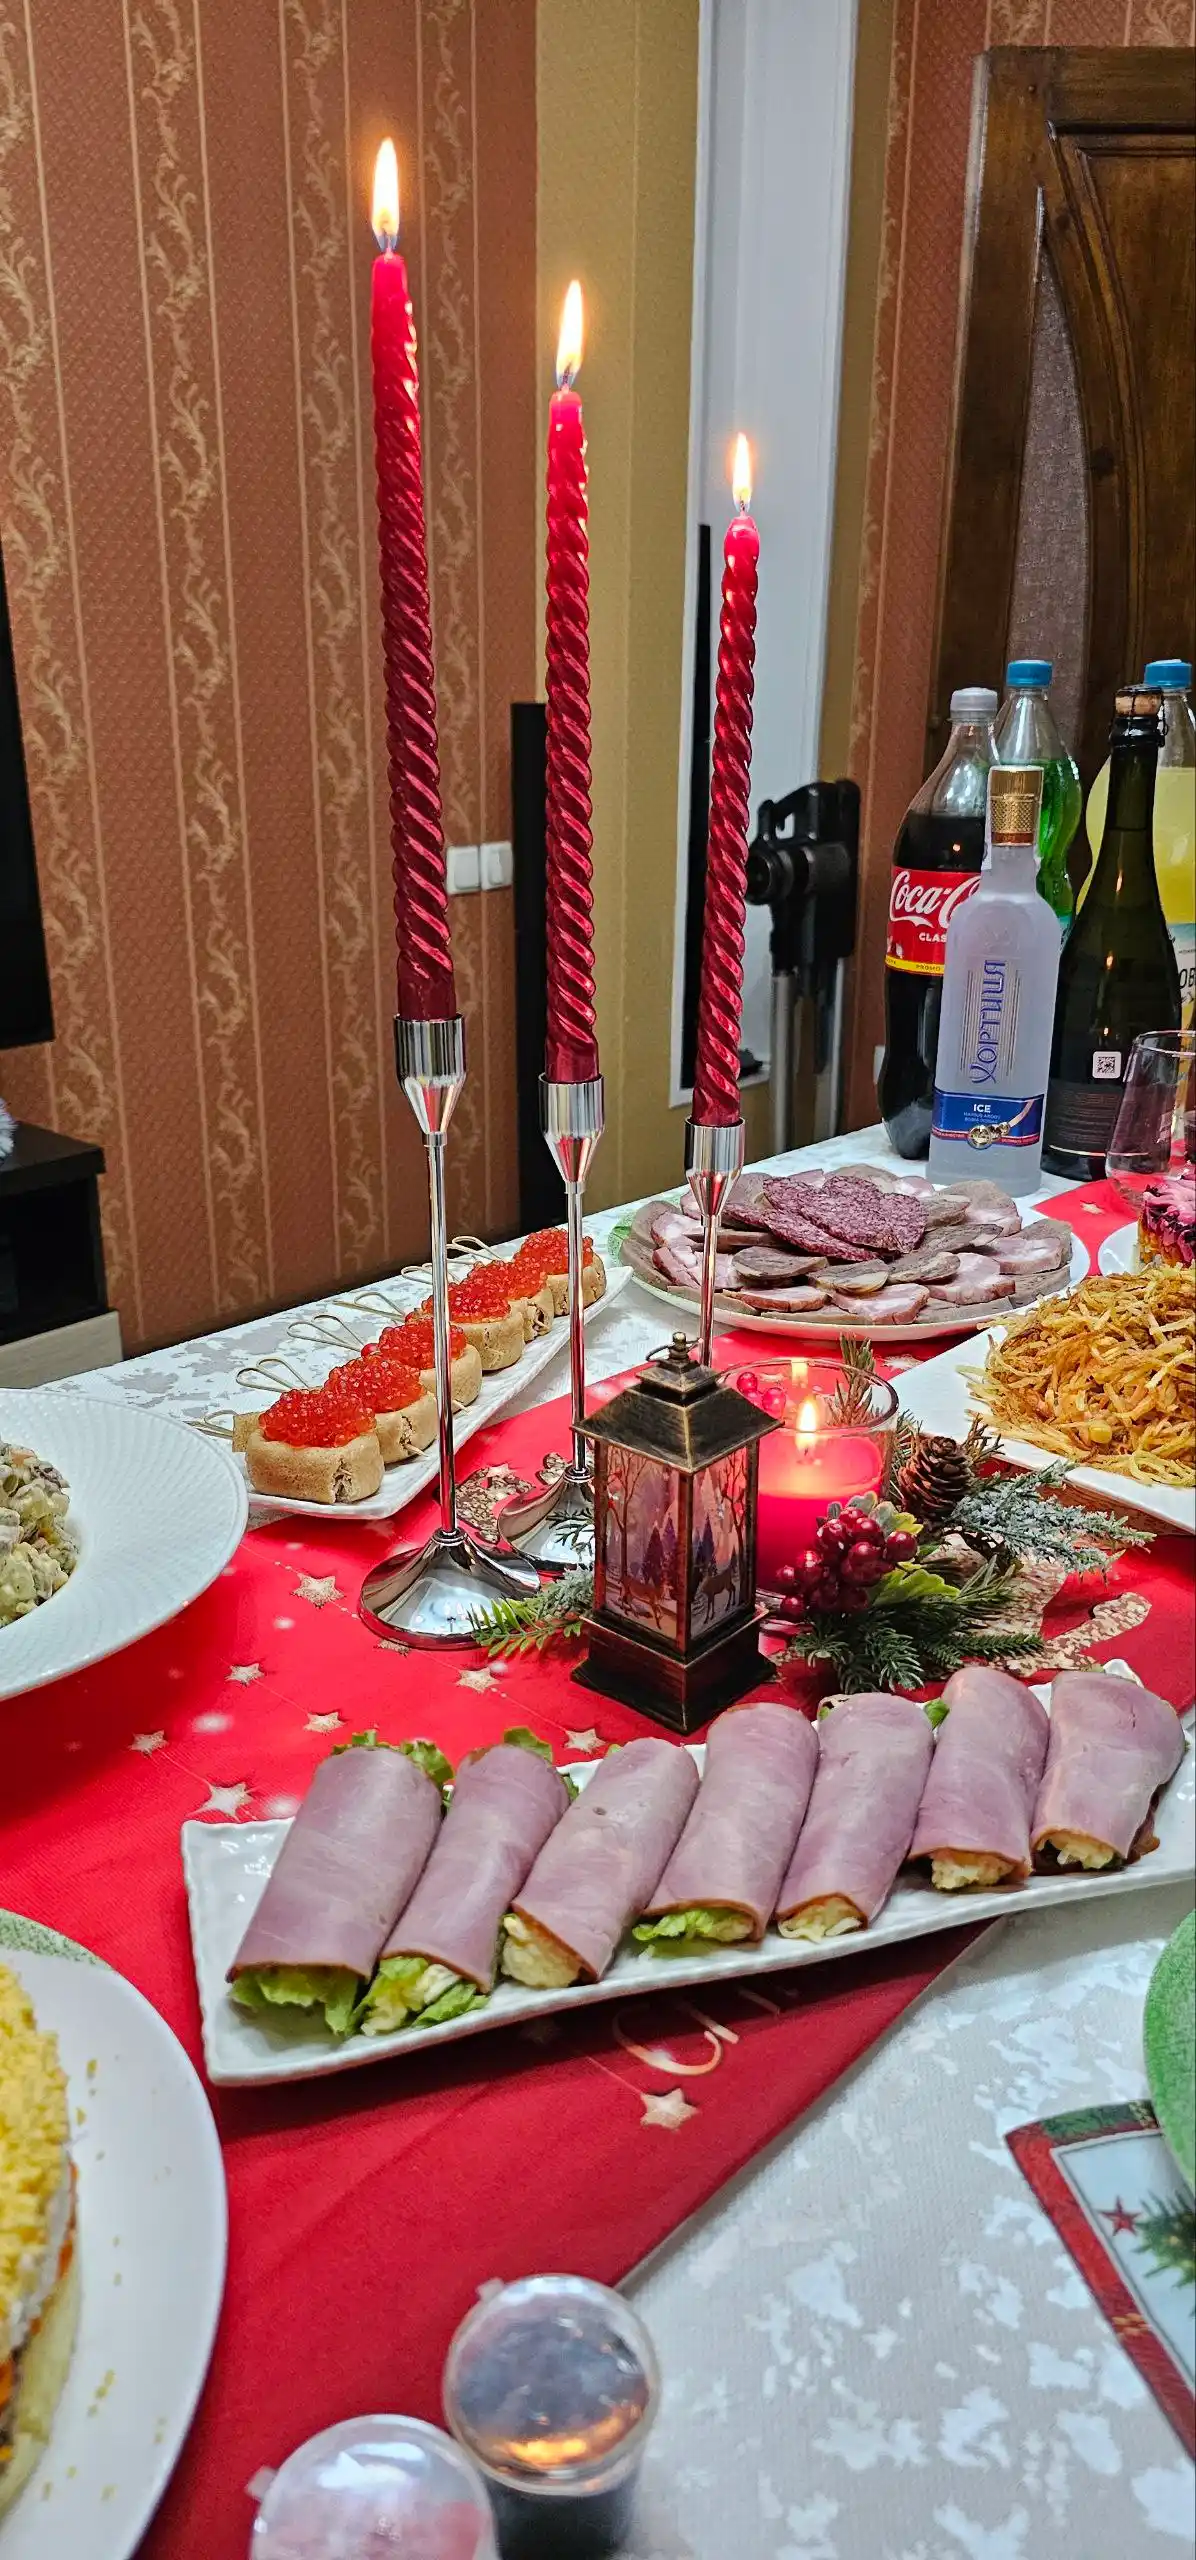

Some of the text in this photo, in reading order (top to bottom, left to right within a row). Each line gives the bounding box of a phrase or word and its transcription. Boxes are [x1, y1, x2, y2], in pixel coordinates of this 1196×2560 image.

[890, 871, 981, 928] Coca-C
[919, 932, 948, 942] CLAS
[973, 1103, 991, 1113] ICE
